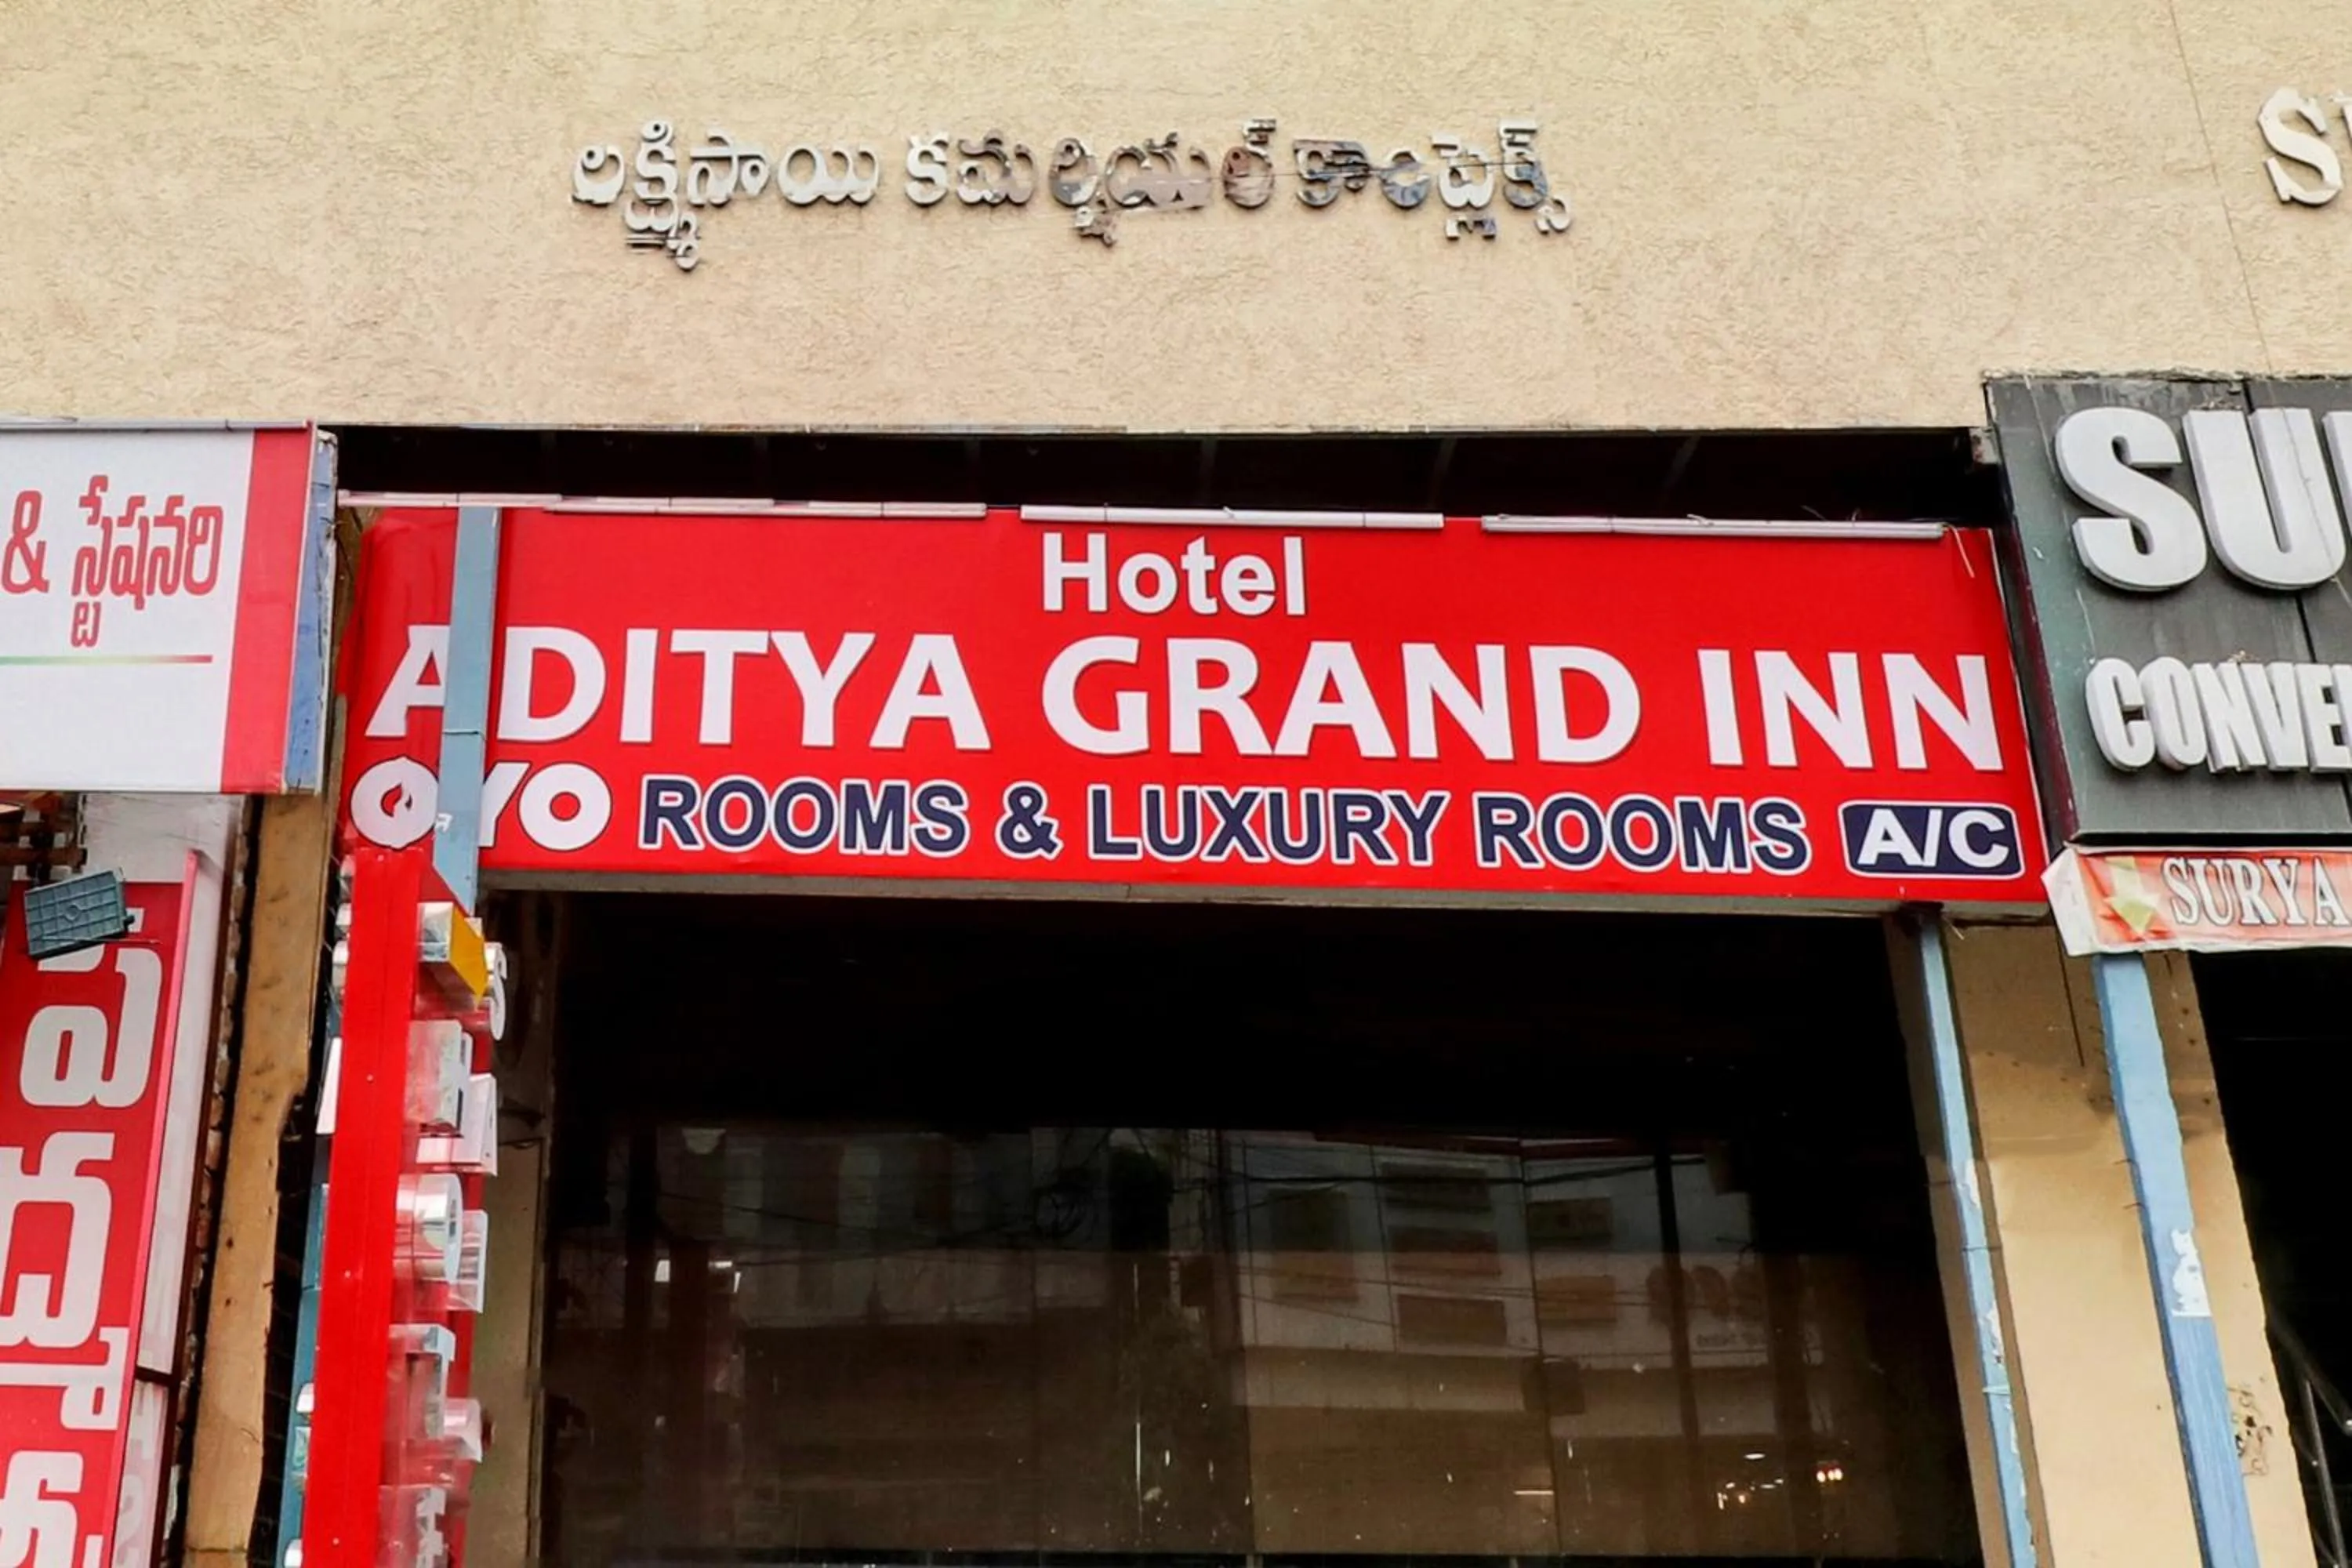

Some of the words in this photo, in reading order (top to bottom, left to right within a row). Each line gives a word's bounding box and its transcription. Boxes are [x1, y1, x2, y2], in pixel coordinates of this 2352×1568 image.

[2257, 86, 2352, 207] S
[1042, 532, 1307, 615] Hotel
[365, 625, 991, 750] ADITYA
[1041, 636, 1642, 763] GRAND
[1697, 648, 2004, 771] INN
[637, 774, 971, 860] ROOMS
[996, 782, 1064, 861] &
[1087, 785, 1450, 866] LUXURY
[1473, 792, 1812, 875] ROOMS
[1857, 808, 2011, 868] A/C
[2161, 856, 2352, 927] SURYA
